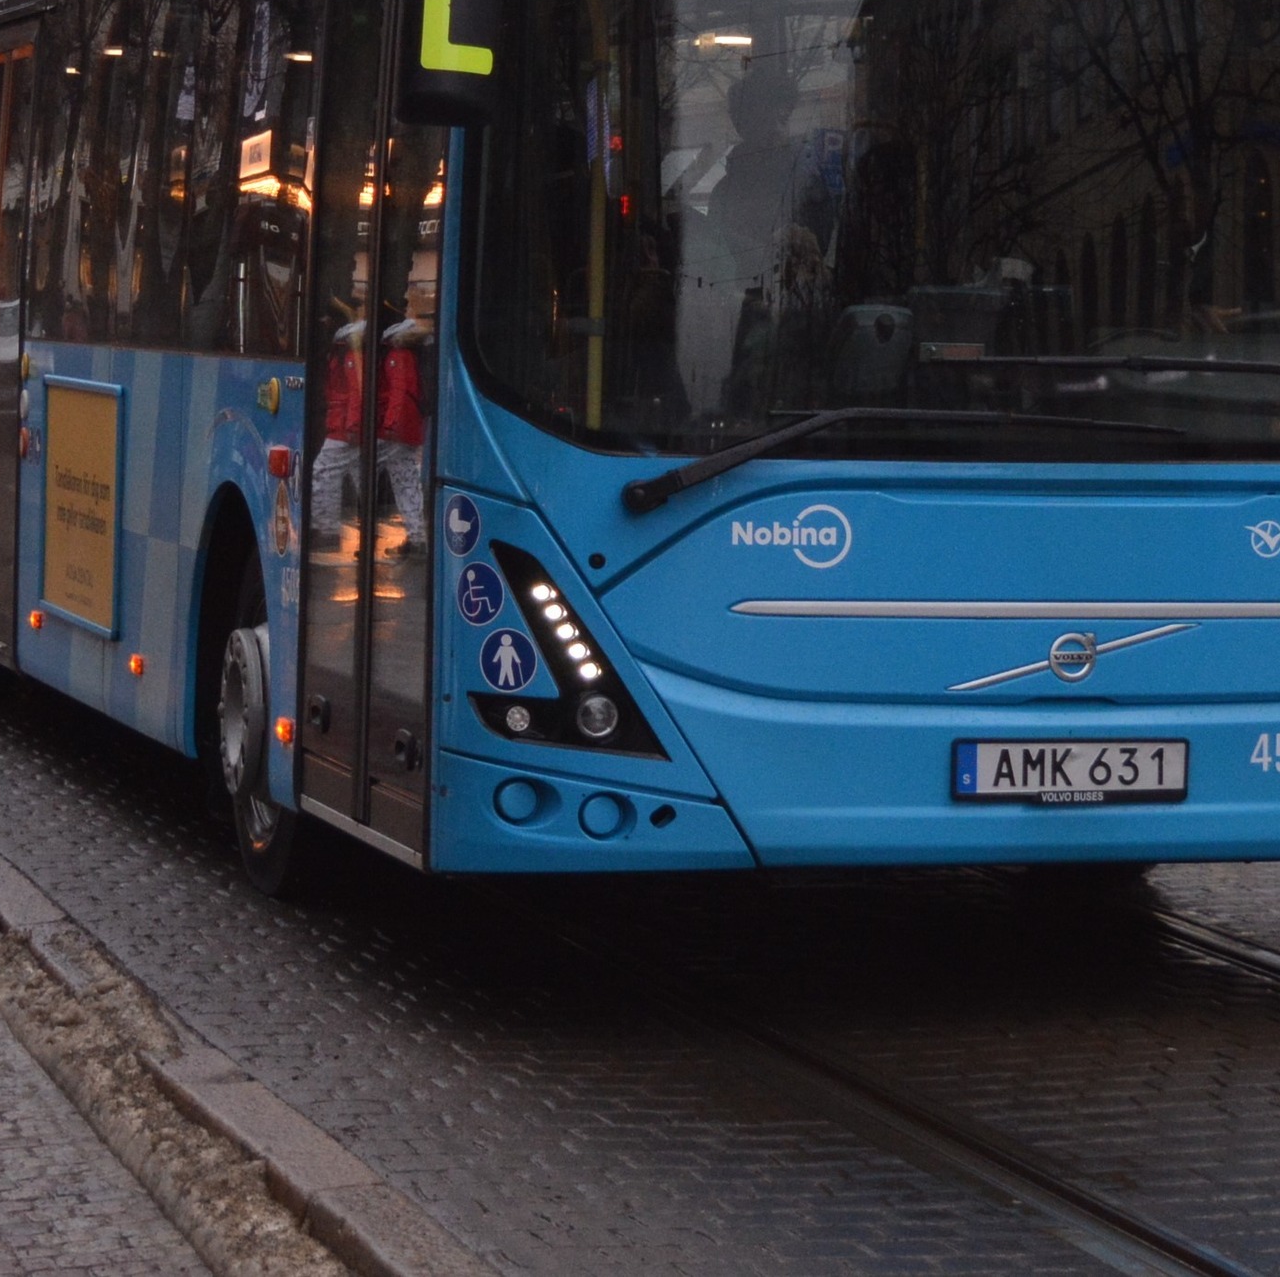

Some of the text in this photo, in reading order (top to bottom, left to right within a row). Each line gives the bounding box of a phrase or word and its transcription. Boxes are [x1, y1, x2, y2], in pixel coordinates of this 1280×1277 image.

[732, 520, 837, 546] Nobina
[1053, 653, 1093, 661] VOLVO
[992, 747, 1165, 788] AMK 631
[962, 772, 971, 786] S
[1041, 790, 1105, 803] VOLVO BUSES
